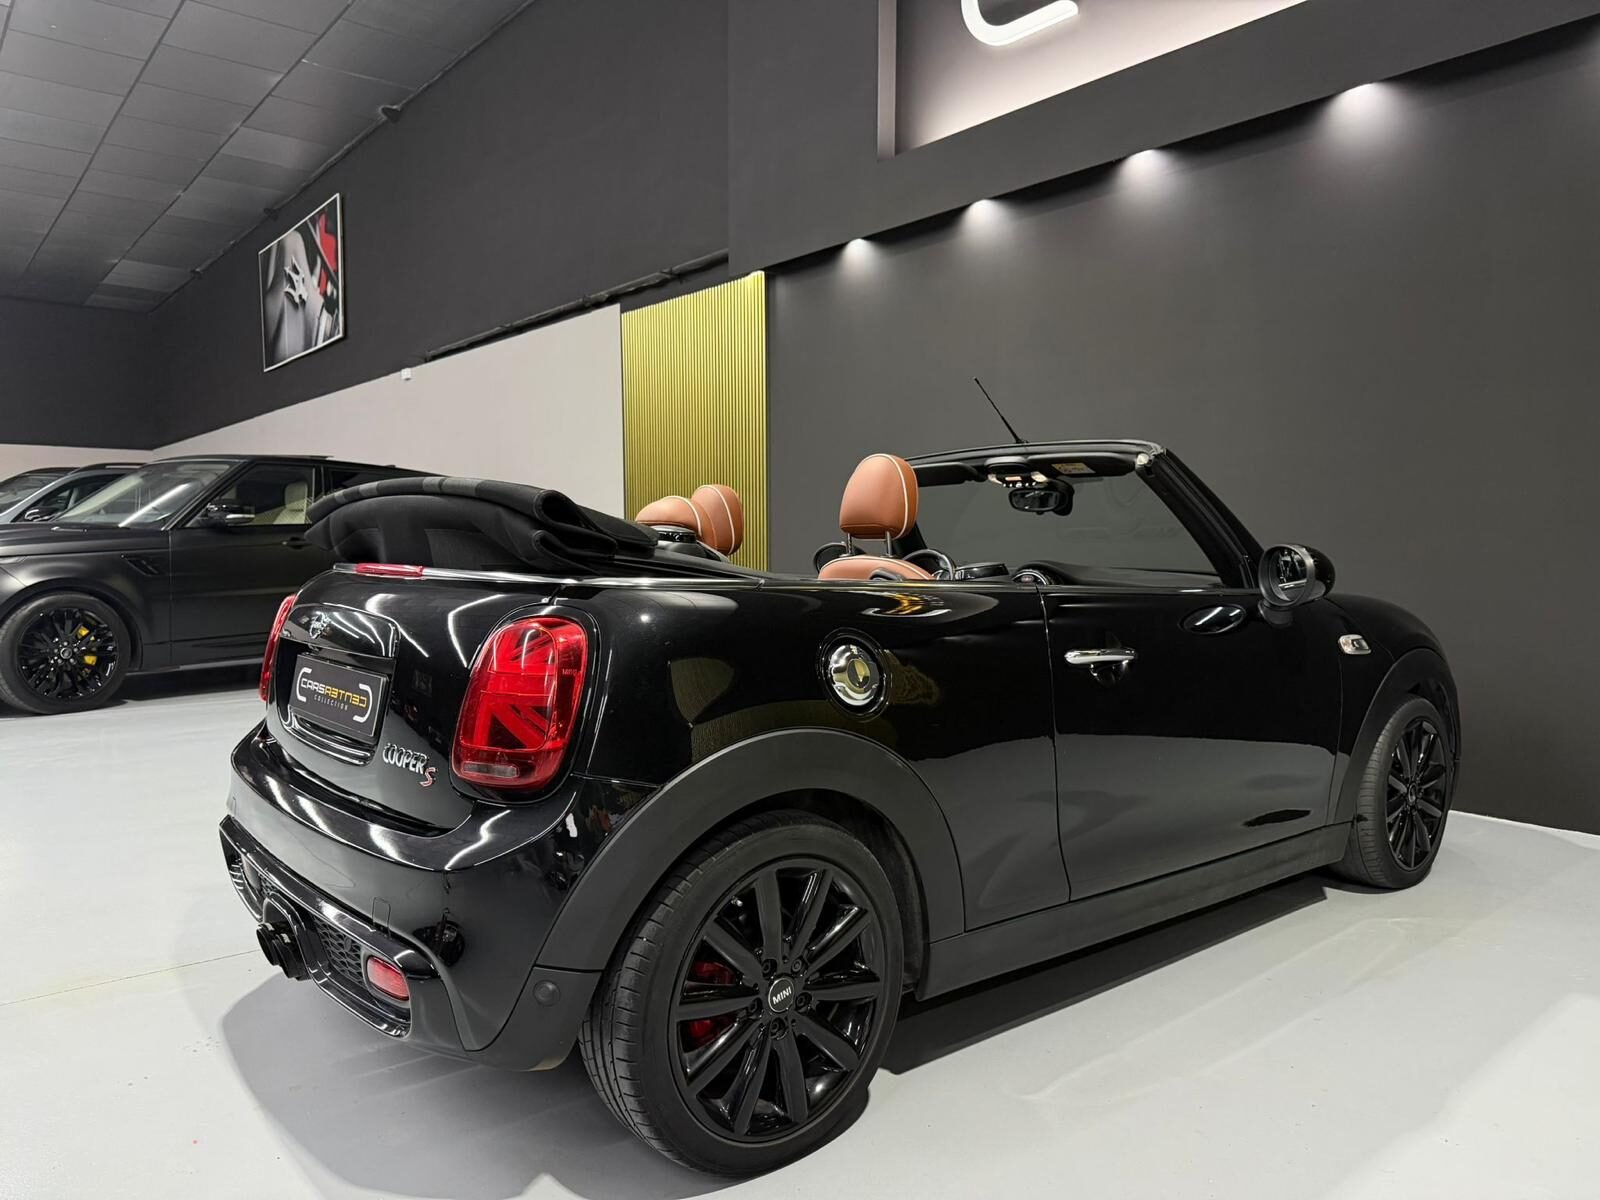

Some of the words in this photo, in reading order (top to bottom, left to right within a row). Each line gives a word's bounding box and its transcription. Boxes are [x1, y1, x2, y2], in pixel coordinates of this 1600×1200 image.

[314, 694, 348, 711] COLLECTION
[382, 742, 427, 775] COOPER
[420, 767, 437, 787] S
[772, 986, 792, 1005] MINI
